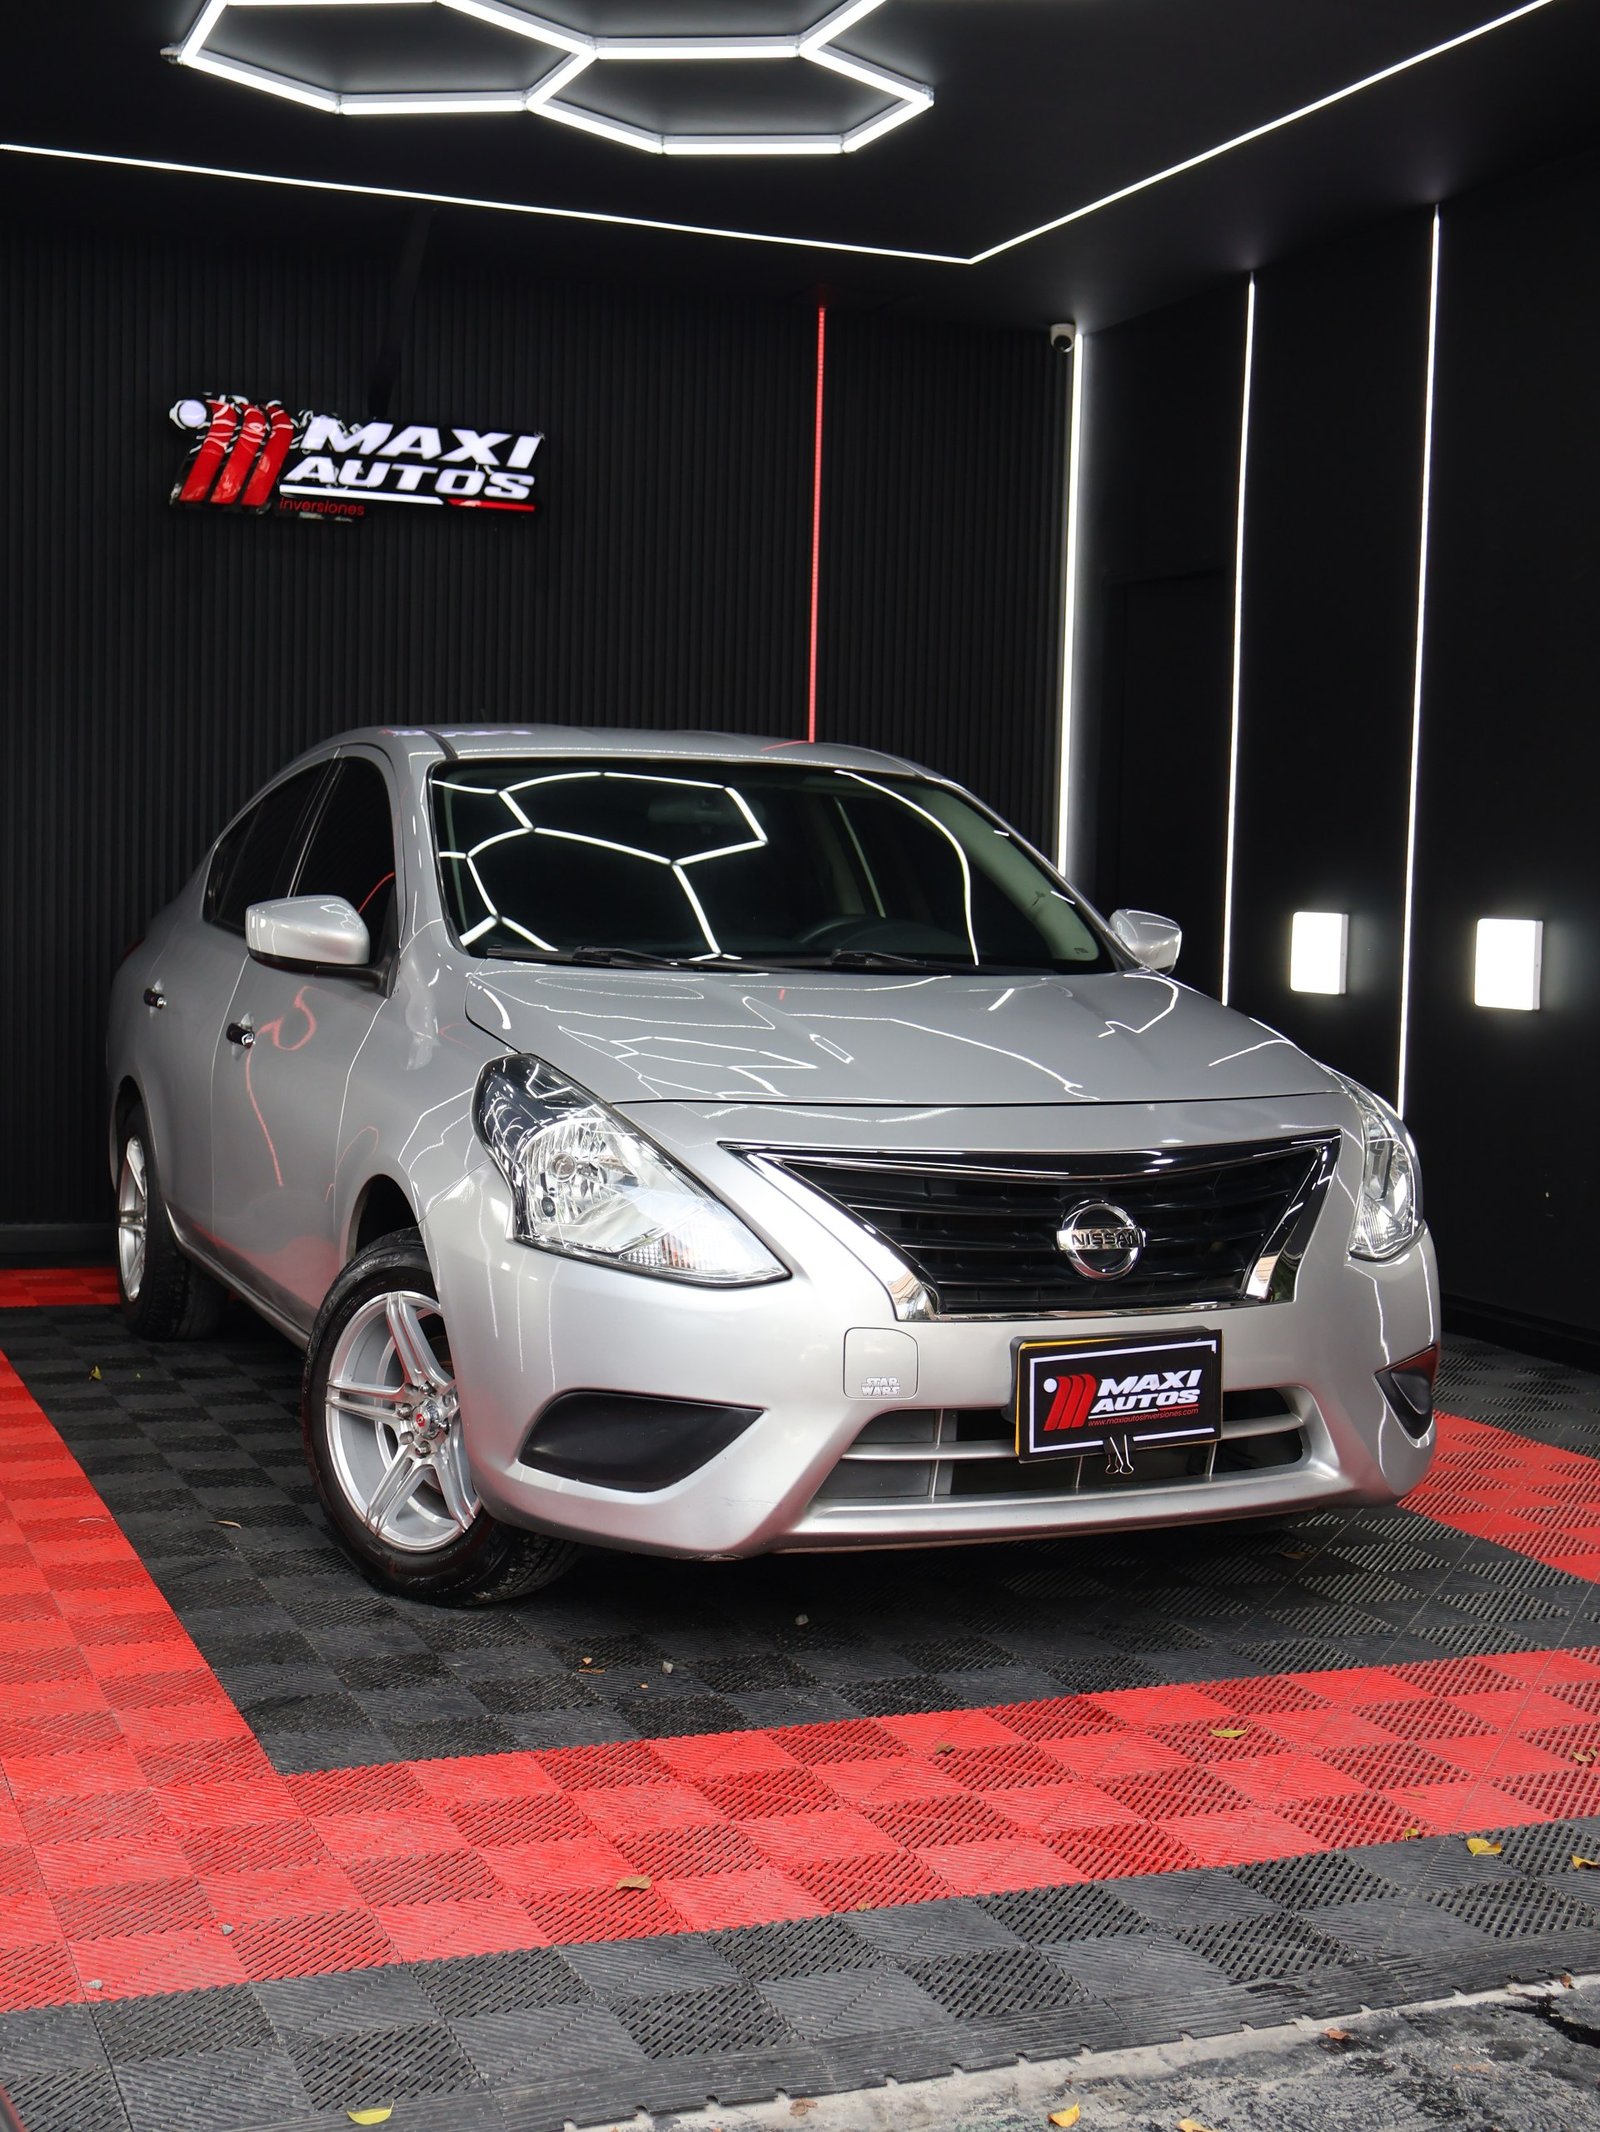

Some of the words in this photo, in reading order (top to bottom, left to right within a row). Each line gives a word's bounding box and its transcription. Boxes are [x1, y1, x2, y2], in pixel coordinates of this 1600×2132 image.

[300, 415, 543, 469] MAXI
[283, 456, 536, 500] AUTOS
[280, 497, 365, 516] inversiones
[1071, 1231, 1139, 1248] NISSAN
[861, 1376, 900, 1387] STAR
[1097, 1369, 1202, 1397] MAXI
[861, 1386, 900, 1397] WARS
[1090, 1389, 1200, 1414] AUTOS
[1087, 1408, 1199, 1427] www.maxiautosinversiones.com
